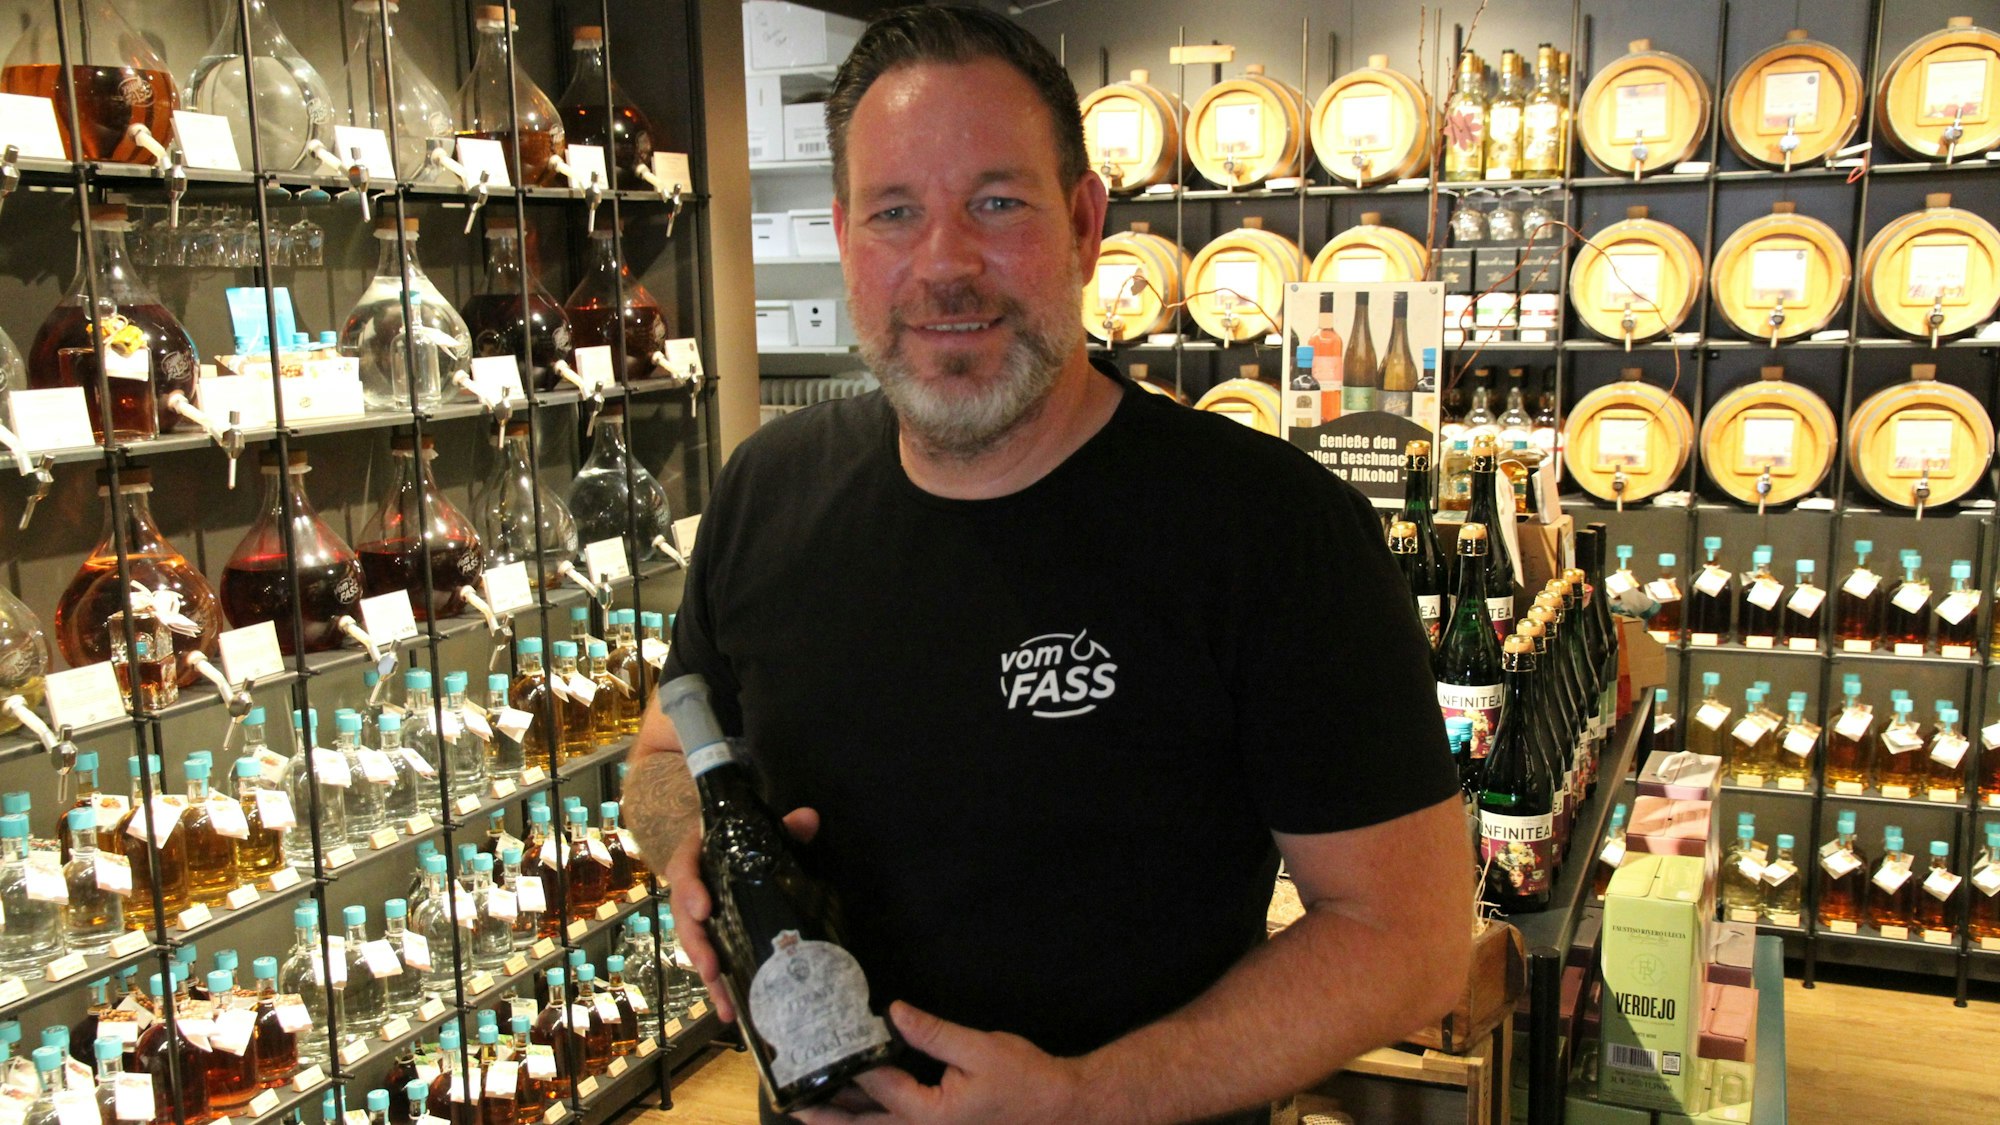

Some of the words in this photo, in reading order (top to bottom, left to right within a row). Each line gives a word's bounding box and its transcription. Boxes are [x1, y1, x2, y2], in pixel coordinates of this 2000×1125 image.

[1373, 435, 1397, 450] den
[1307, 450, 1337, 464] llen
[1341, 451, 1407, 466] Geschmac
[1351, 468, 1398, 483] Alkohol
[1001, 645, 1063, 673] vom
[1008, 663, 1118, 709] FASS
[1616, 992, 1675, 1020] VERDEJO
